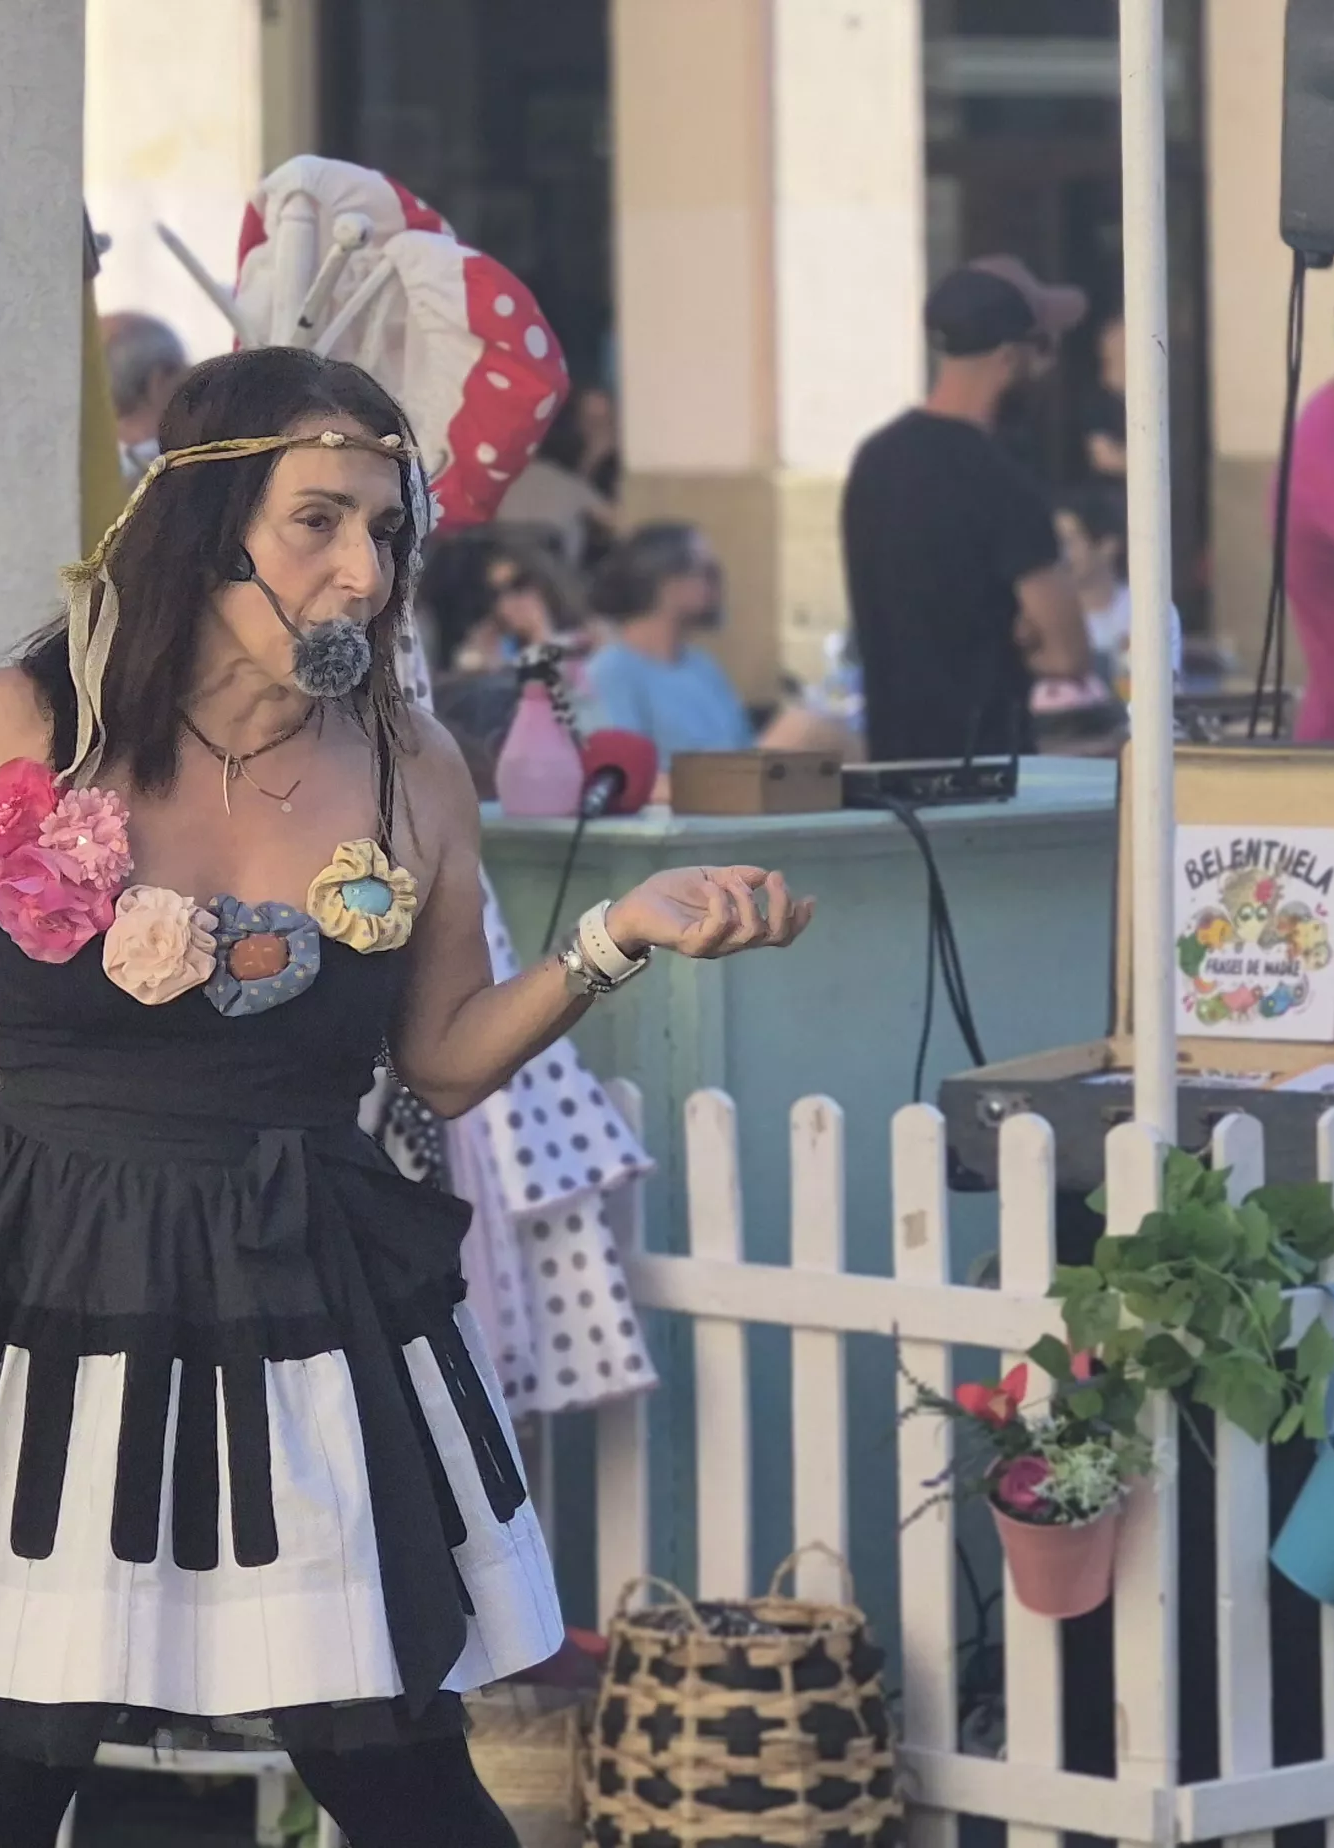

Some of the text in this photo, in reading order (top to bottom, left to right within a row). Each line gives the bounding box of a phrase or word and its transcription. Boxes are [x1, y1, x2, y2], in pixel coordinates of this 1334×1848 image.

[1184, 838, 1334, 896] BELENTUELA
[1246, 959, 1260, 976] DE
[1264, 961, 1301, 977] MADRE
